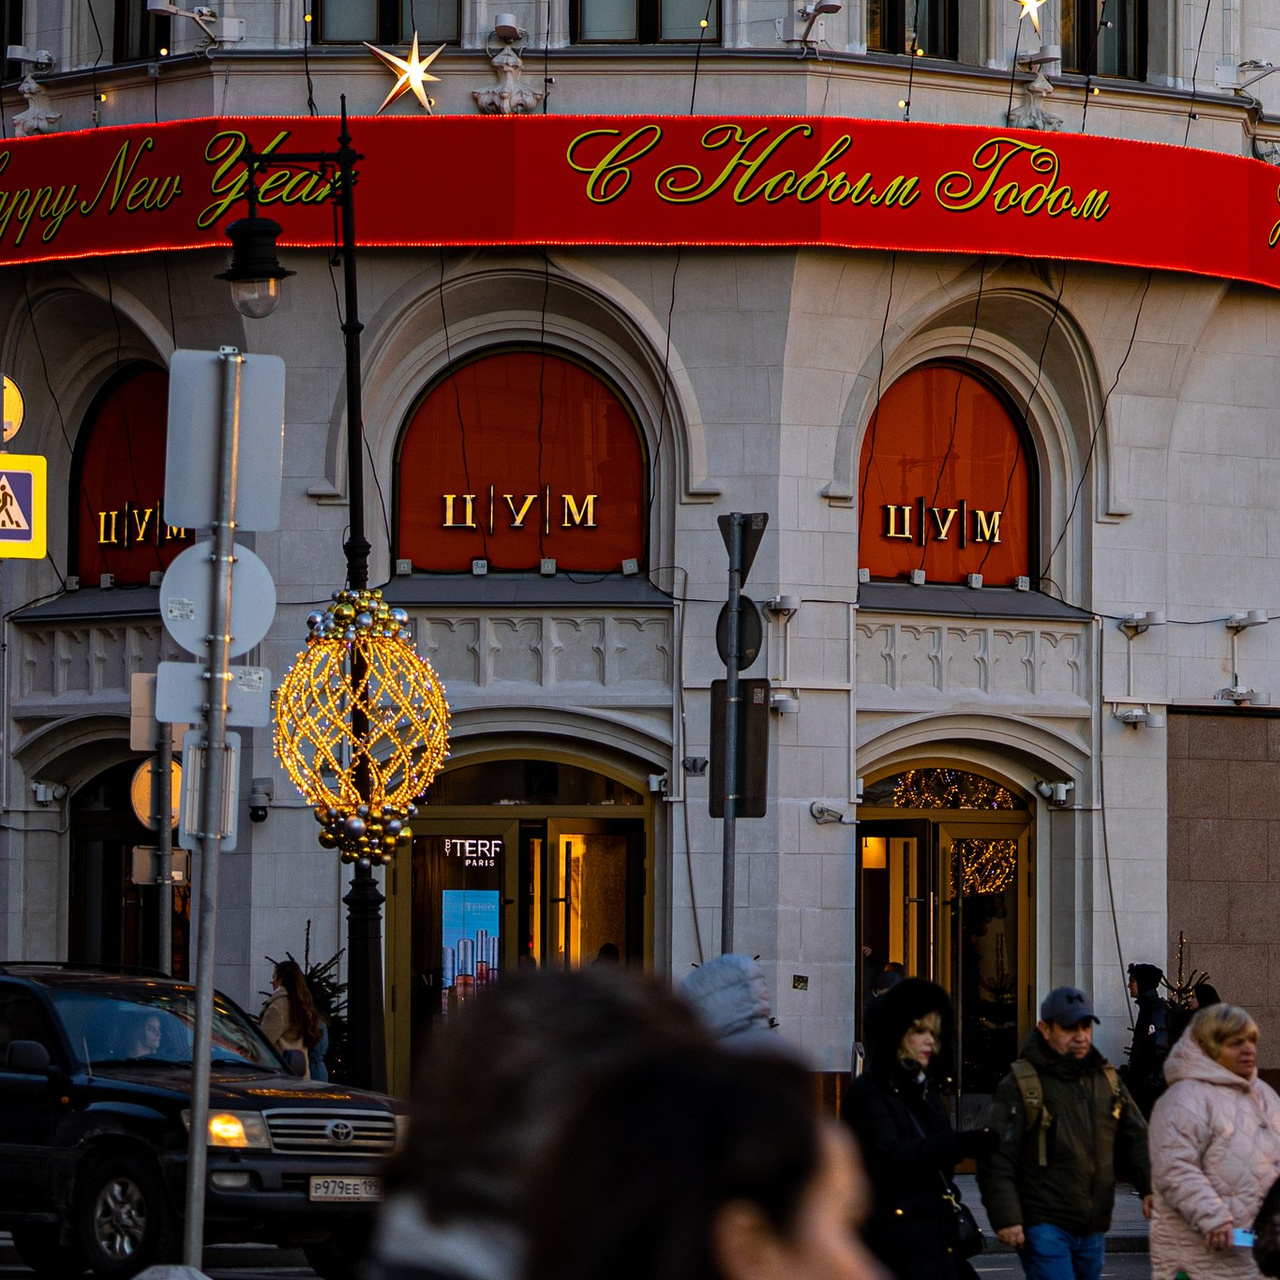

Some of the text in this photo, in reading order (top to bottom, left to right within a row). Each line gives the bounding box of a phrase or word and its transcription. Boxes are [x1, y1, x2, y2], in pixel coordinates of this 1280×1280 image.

[0, 149, 77, 244] ppy
[80, 137, 183, 213] New
[566, 123, 1111, 221] С Новым Годом
[465, 859, 495, 867] PARIS
